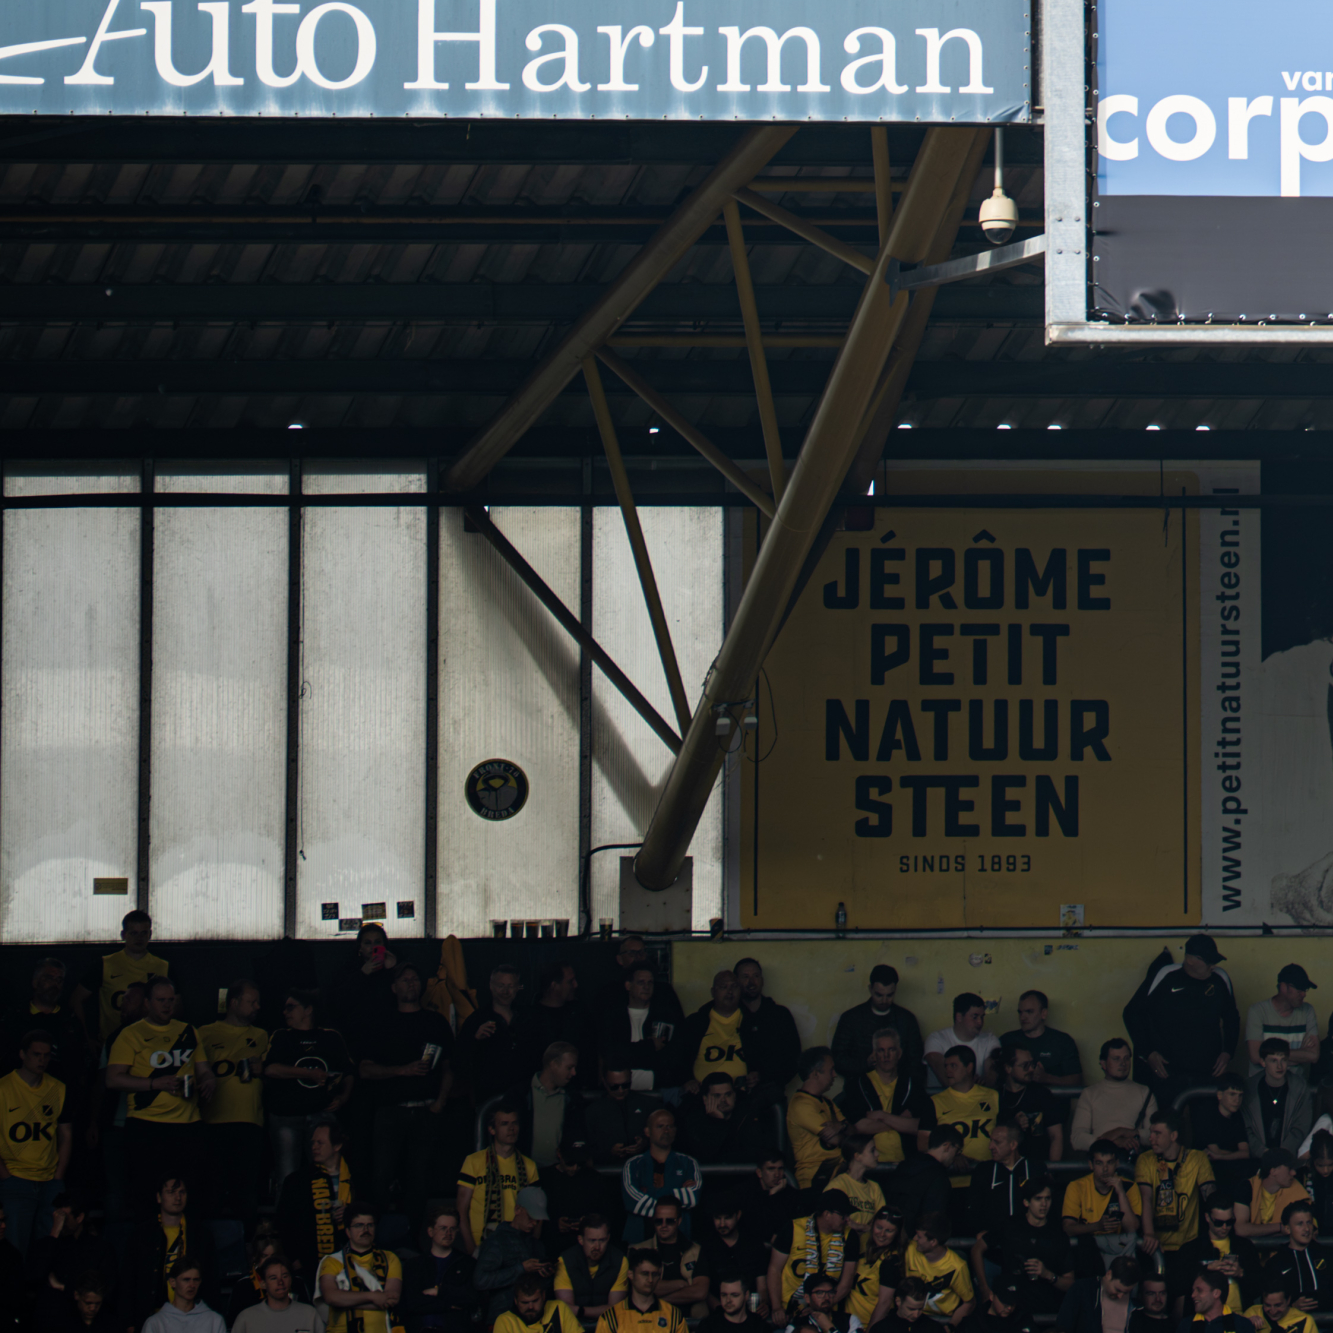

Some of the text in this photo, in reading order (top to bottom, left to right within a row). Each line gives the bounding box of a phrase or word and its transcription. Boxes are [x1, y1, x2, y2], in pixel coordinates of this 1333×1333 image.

[823, 529, 1111, 610] JÉRÔME
[870, 623, 1070, 686] PETIT
[825, 699, 1112, 762] NATUUR
[854, 774, 1080, 838] STEEN
[899, 855, 1032, 873] SINDS 1893
[150, 1048, 194, 1069] OK
[10, 1122, 53, 1143] OK
[315, 1213, 335, 1261] BRED
